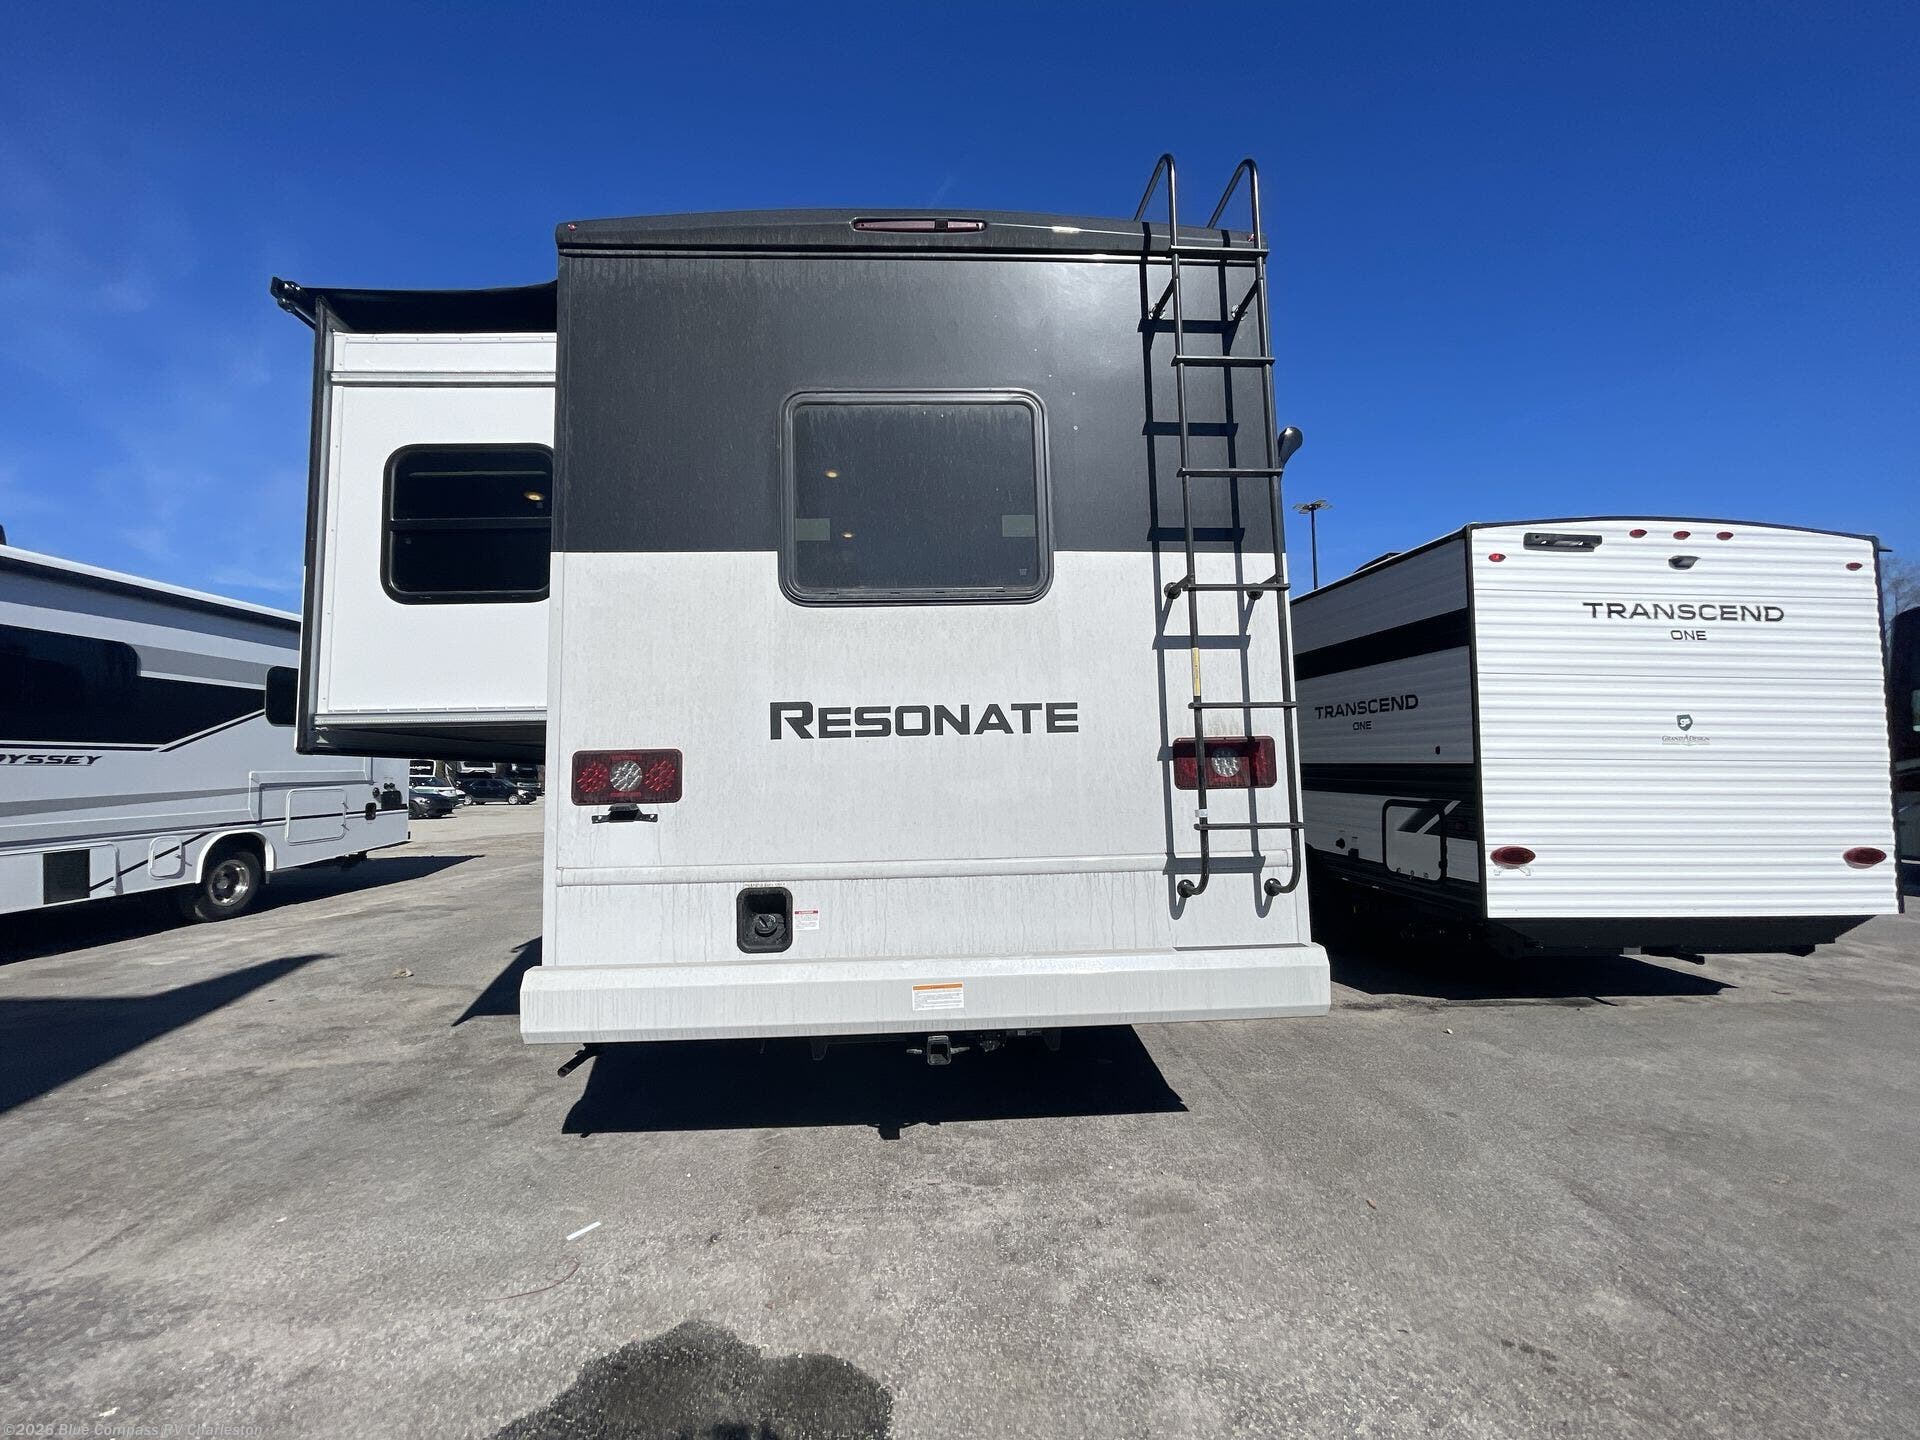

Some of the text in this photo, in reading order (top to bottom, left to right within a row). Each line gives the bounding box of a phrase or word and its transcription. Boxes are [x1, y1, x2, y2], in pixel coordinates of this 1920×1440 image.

[1582, 602, 1785, 623] TRANSCEND
[1670, 630, 1707, 641] ONE
[1315, 694, 1419, 720] TRANSCEND
[769, 701, 1079, 740] RESONATE
[1352, 721, 1372, 731] ONE
